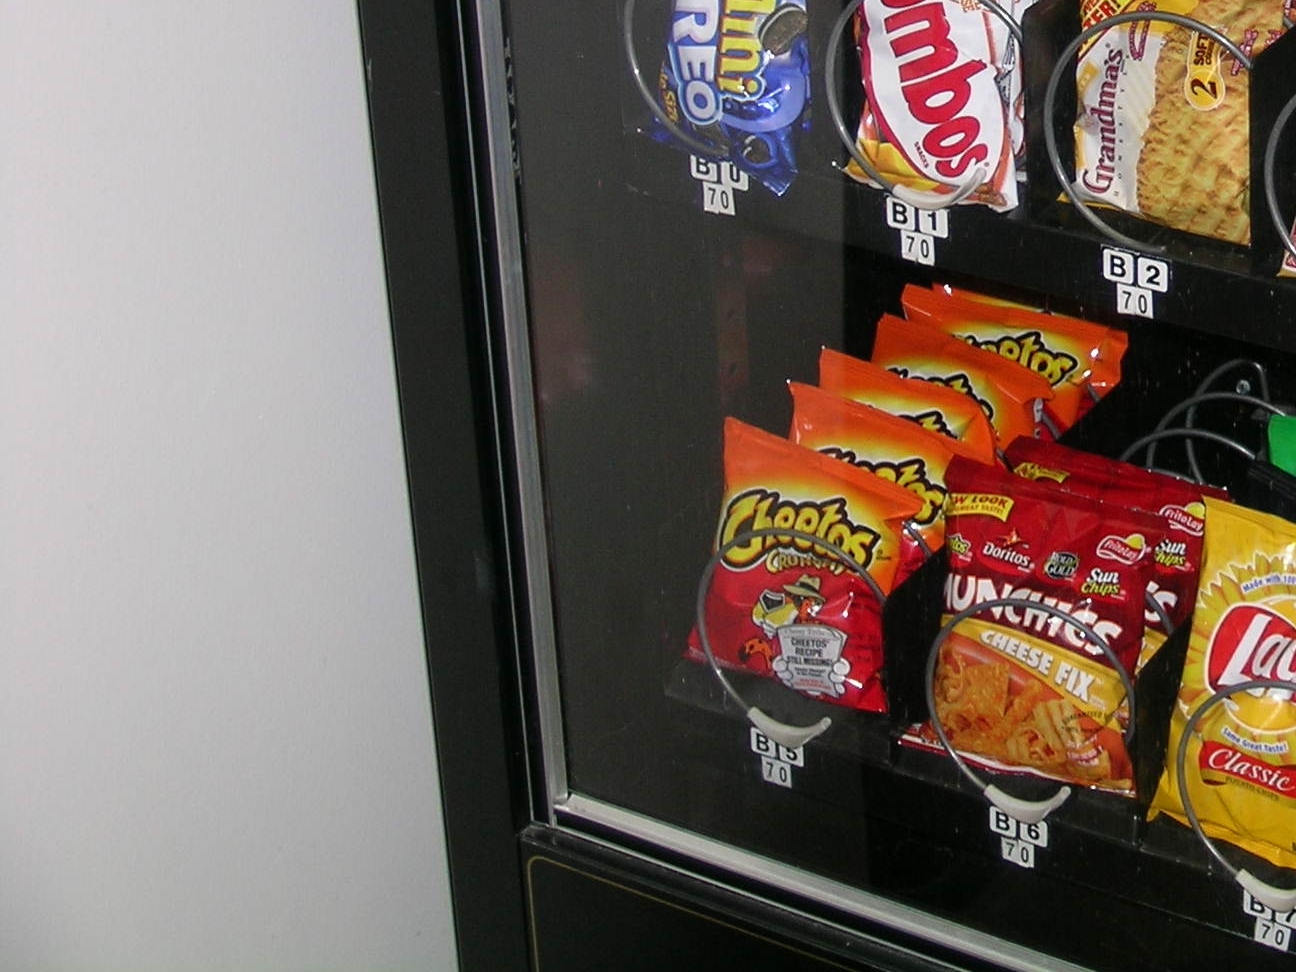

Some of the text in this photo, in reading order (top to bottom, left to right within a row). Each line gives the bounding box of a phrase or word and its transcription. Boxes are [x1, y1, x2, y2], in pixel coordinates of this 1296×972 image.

[1190, 78, 1218, 100] 2
[1082, 48, 1123, 195] Grandma's
[913, 140, 931, 170] SNACKS
[708, 188, 730, 210] 70
[906, 235, 930, 260] 70
[1122, 290, 1148, 314] 70
[972, 495, 1008, 509] LOOK
[720, 490, 878, 570] Cheetos
[983, 542, 1032, 567] Doritos
[1156, 539, 1186, 555] Sun
[1046, 561, 1077, 577] GOLD
[1087, 567, 1120, 583] Sun
[1080, 580, 1120, 596] Chips
[1243, 579, 1263, 594] Made
[1265, 575, 1281, 585] with
[980, 630, 1096, 702] CHEESE FIX
[1222, 728, 1241, 743] Same
[1241, 738, 1262, 751] Great
[766, 761, 787, 783] 70
[1207, 748, 1296, 792] Classic
[1005, 841, 1029, 864] 70
[1262, 923, 1285, 946] 70
